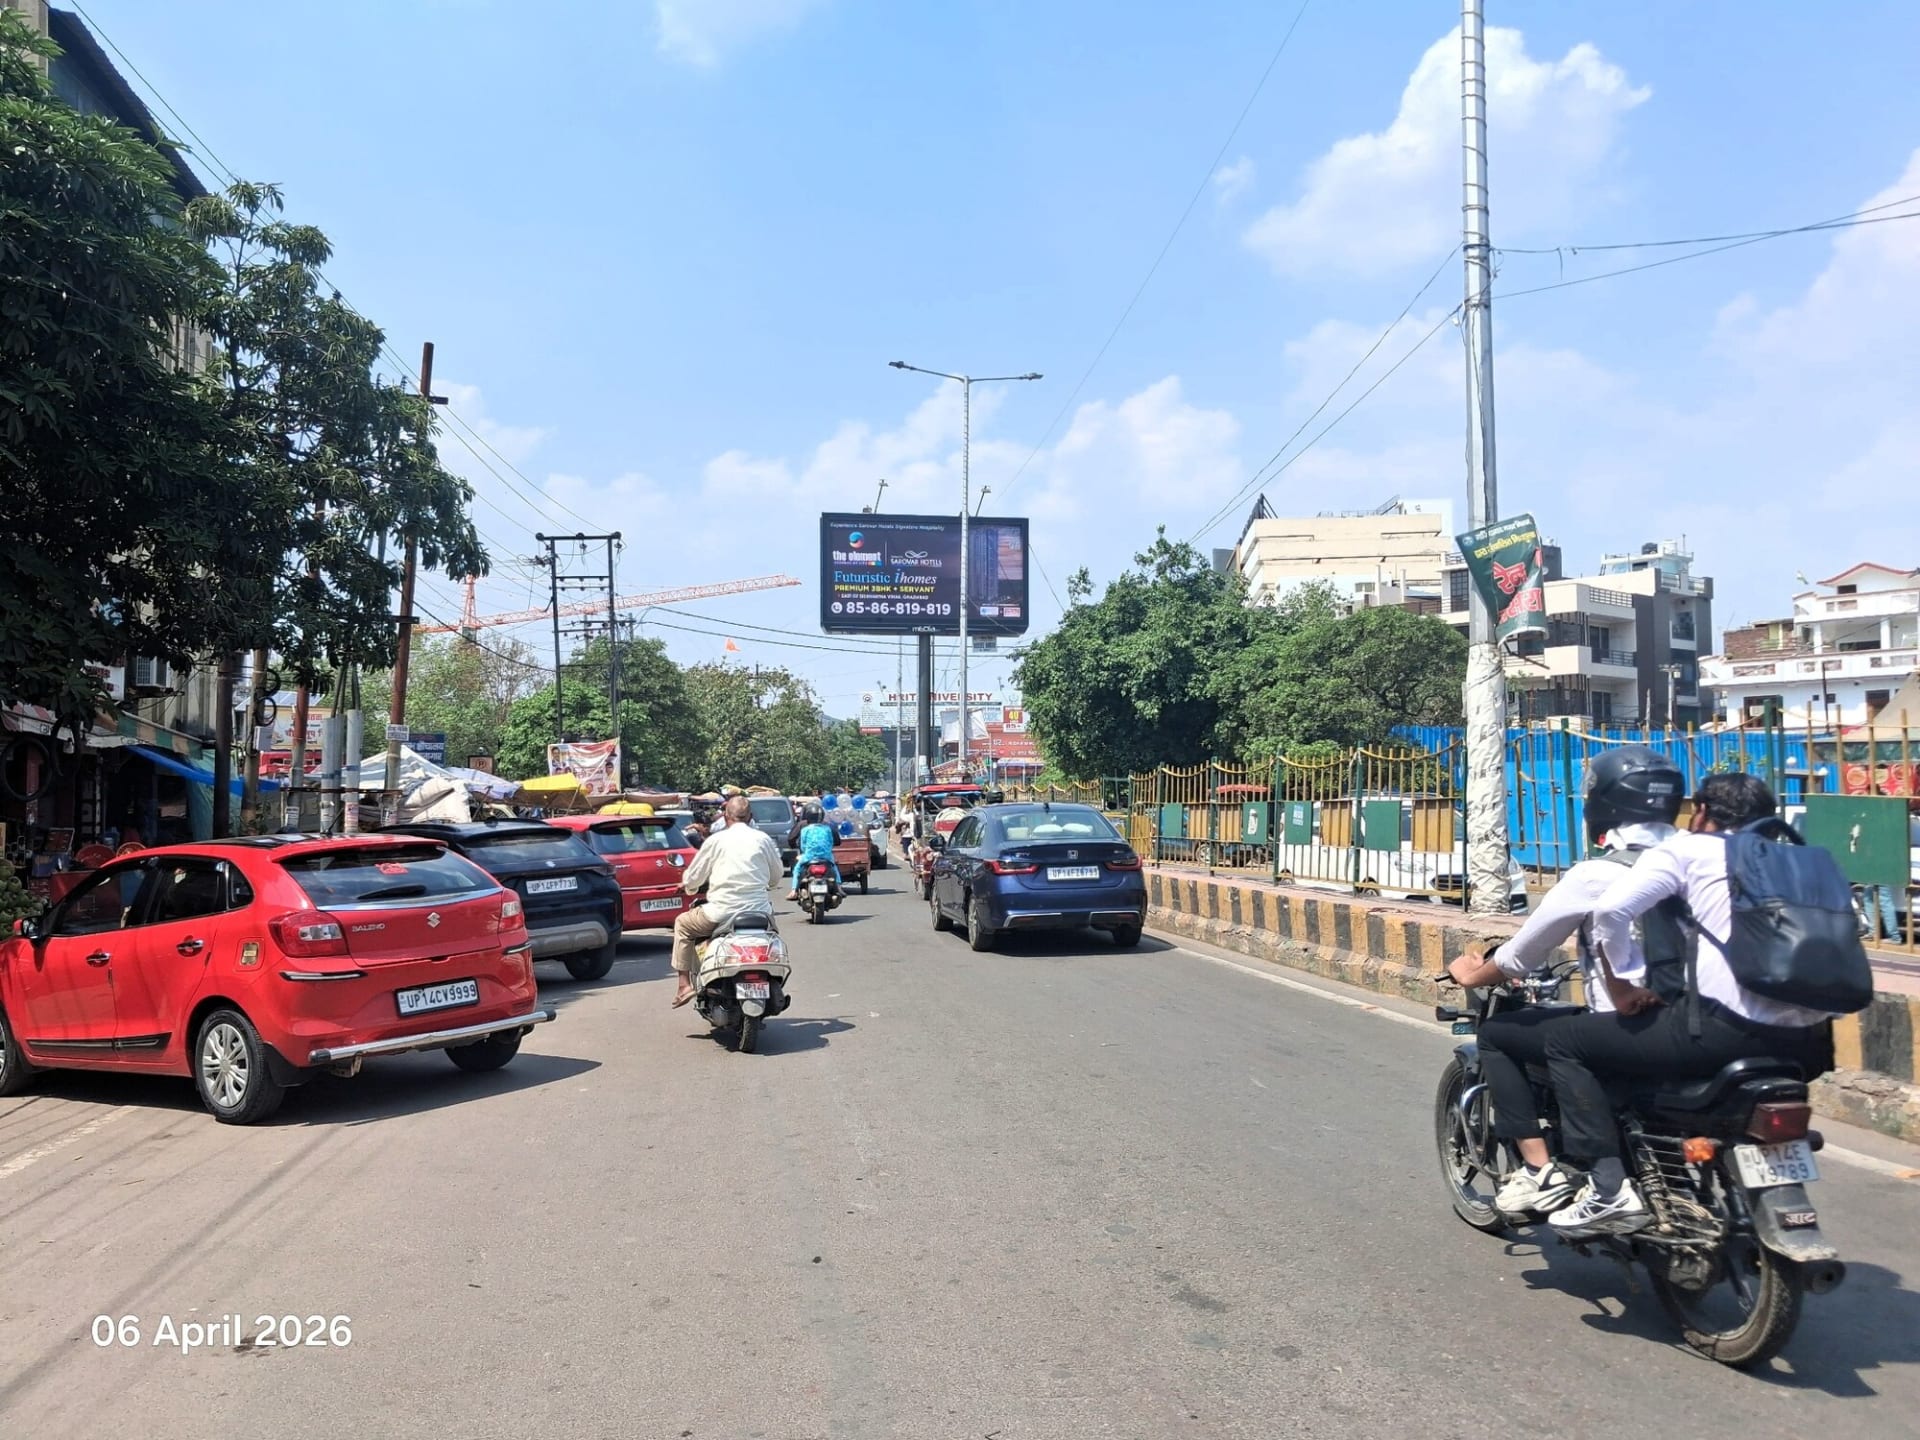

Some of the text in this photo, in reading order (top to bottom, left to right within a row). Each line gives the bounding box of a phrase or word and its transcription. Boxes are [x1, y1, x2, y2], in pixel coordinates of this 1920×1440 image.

[832, 550, 882, 562] the element
[890, 558, 943, 567] SAROVAR HOTELS
[834, 570, 891, 584] Futuristic
[834, 584, 869, 592] PREMIUM
[899, 585, 935, 593] SERVANT
[846, 601, 951, 616] 85-86-819-819
[928, 692, 993, 701] NIVESITY
[352, 922, 386, 932] BALENO
[406, 984, 477, 1009] UP14CV9999
